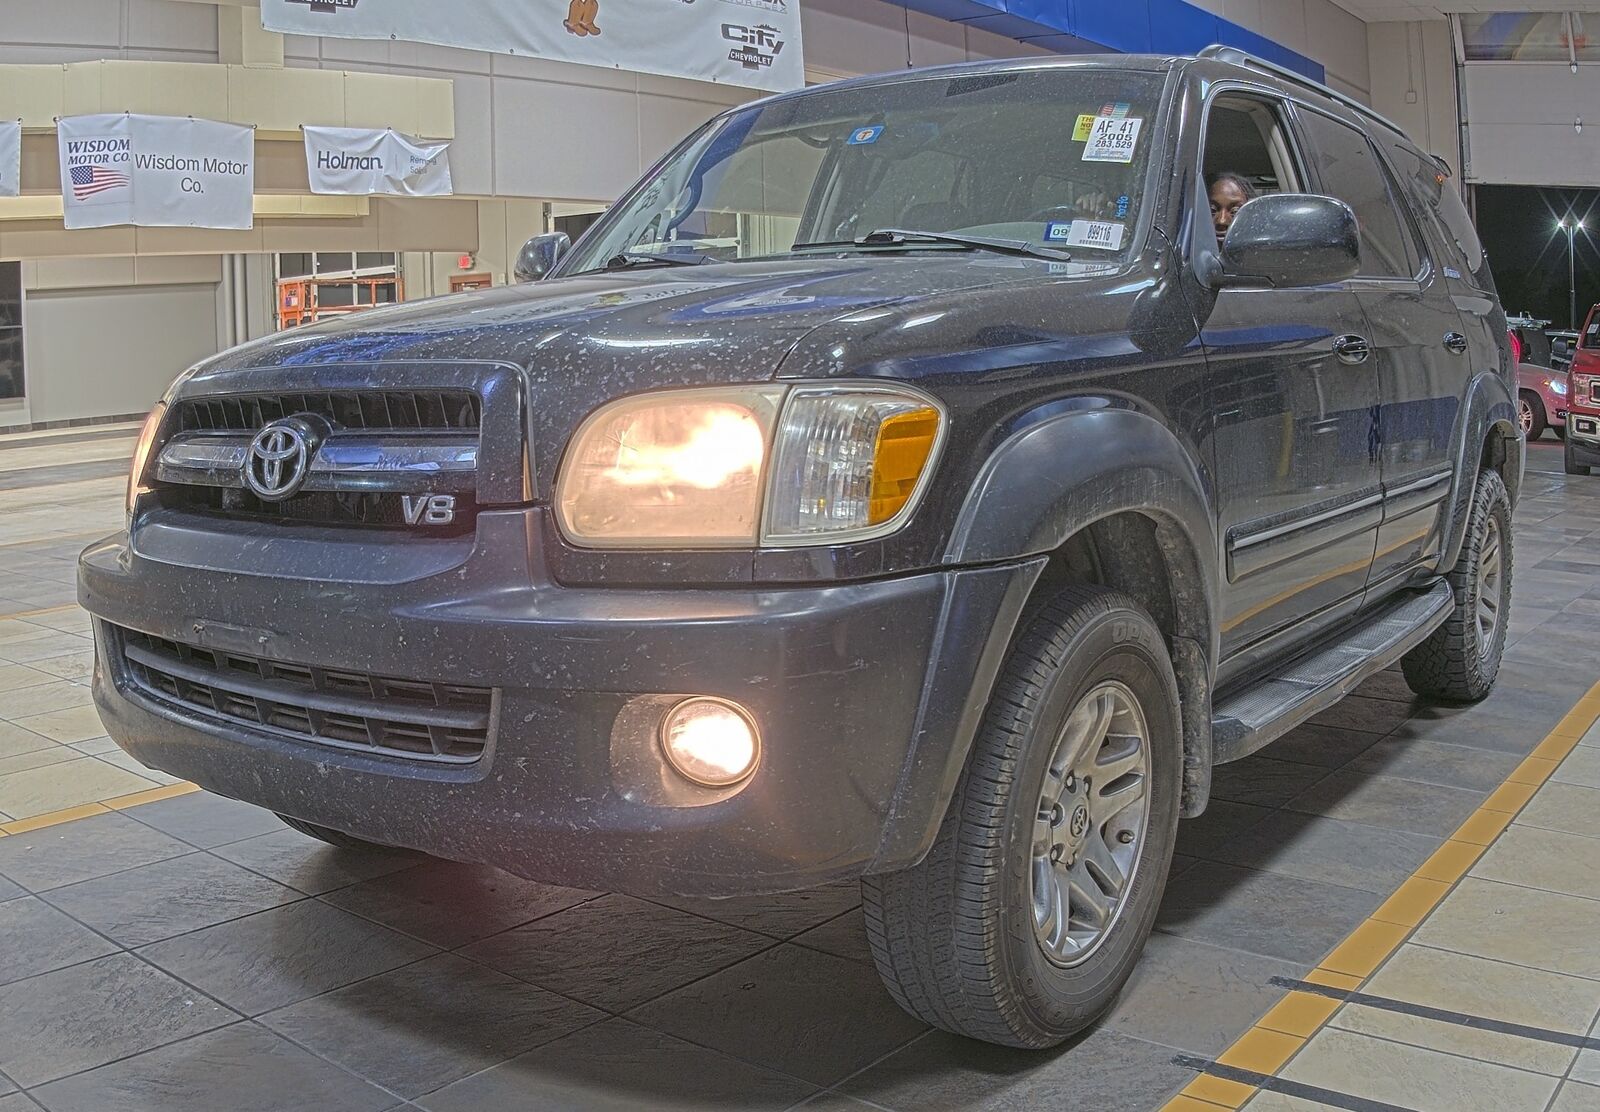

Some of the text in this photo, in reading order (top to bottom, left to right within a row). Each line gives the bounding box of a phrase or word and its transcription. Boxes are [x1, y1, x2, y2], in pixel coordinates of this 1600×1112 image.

[721, 24, 784, 54] City
[730, 51, 771, 65] CHEVROLET
[1097, 120, 1134, 134] AF 41
[67, 139, 131, 154] WISDOM
[1095, 140, 1133, 149] 283,529
[68, 152, 131, 165] MOTOR CO.
[135, 153, 248, 175] Wisdom Motor
[181, 177, 204, 193] Co.
[401, 494, 455, 525] V8
